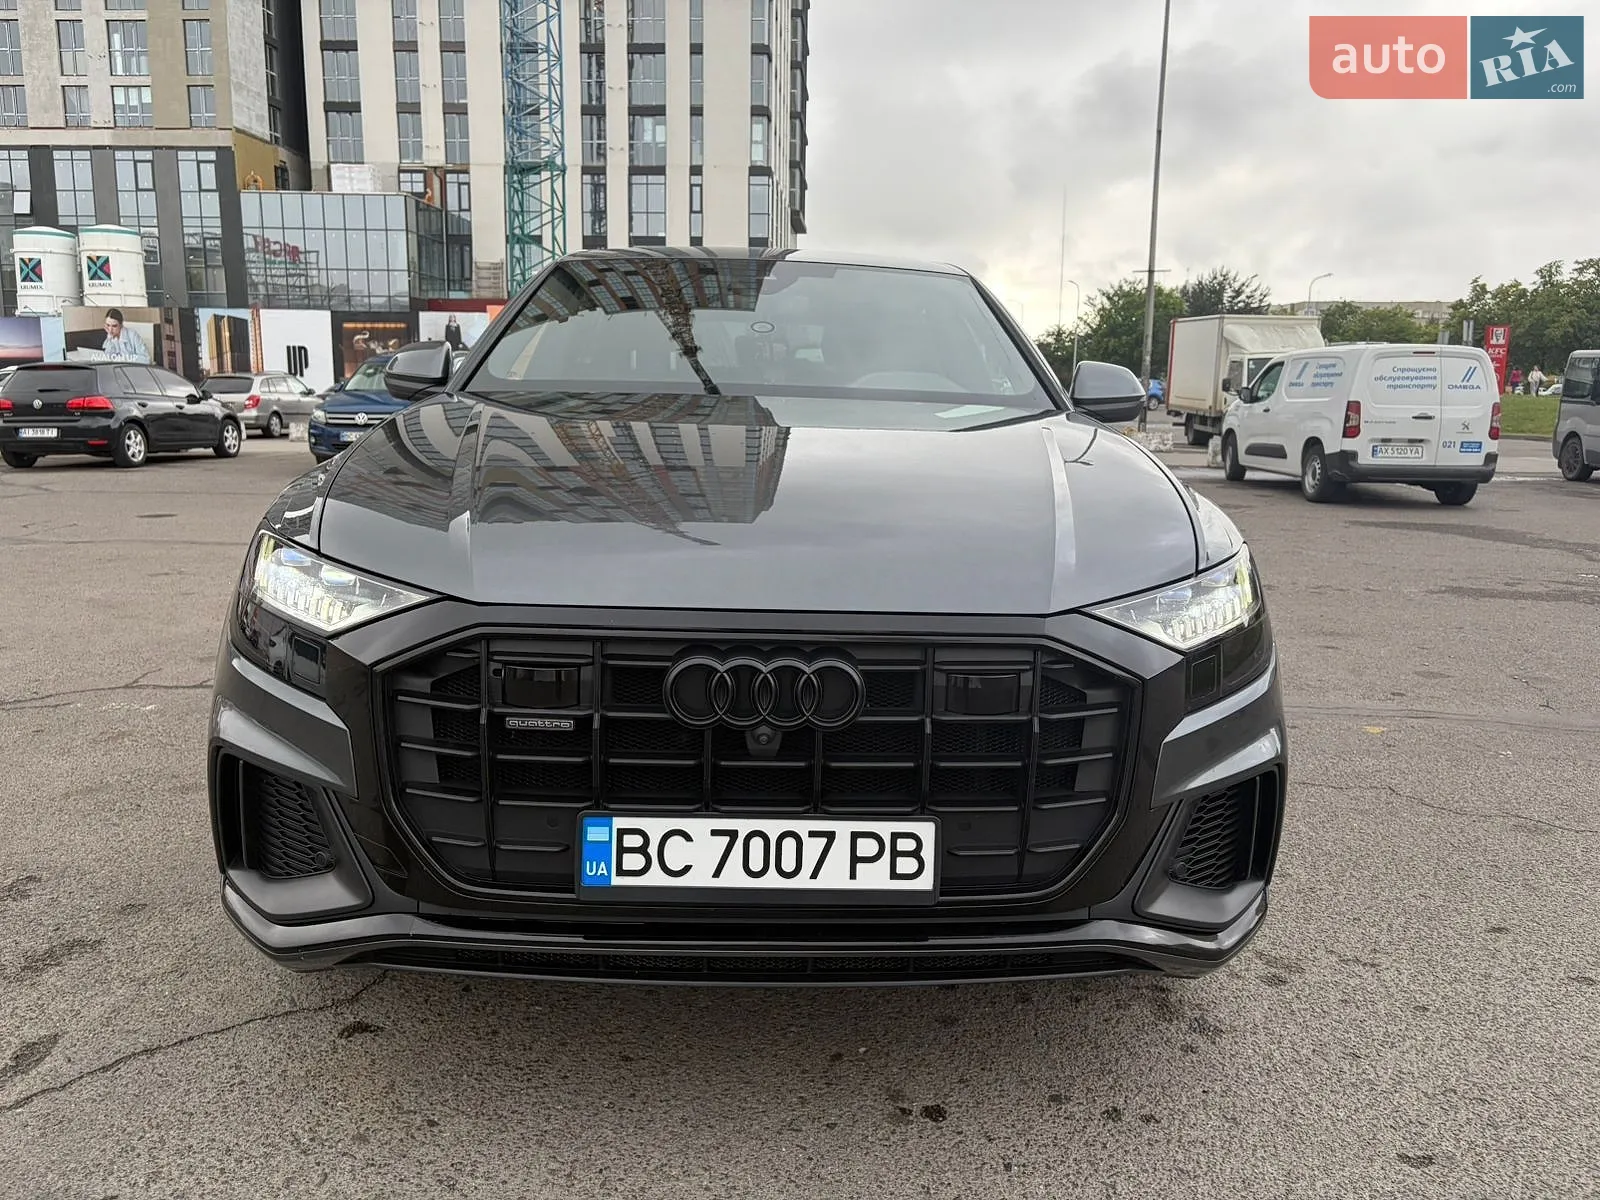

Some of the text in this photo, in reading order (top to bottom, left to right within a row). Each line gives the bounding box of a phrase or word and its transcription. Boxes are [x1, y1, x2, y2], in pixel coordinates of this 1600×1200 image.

[286, 345, 309, 377] UP
[1392, 366, 1437, 374] Спрощуємо
[1386, 383, 1437, 391] транспорту
[1442, 440, 1456, 449] 021
[1378, 447, 1389, 456] AX
[1409, 447, 1420, 456] YA
[509, 720, 570, 729] quattro
[615, 828, 925, 881] BC 7007 PB
[586, 861, 608, 876] UA
